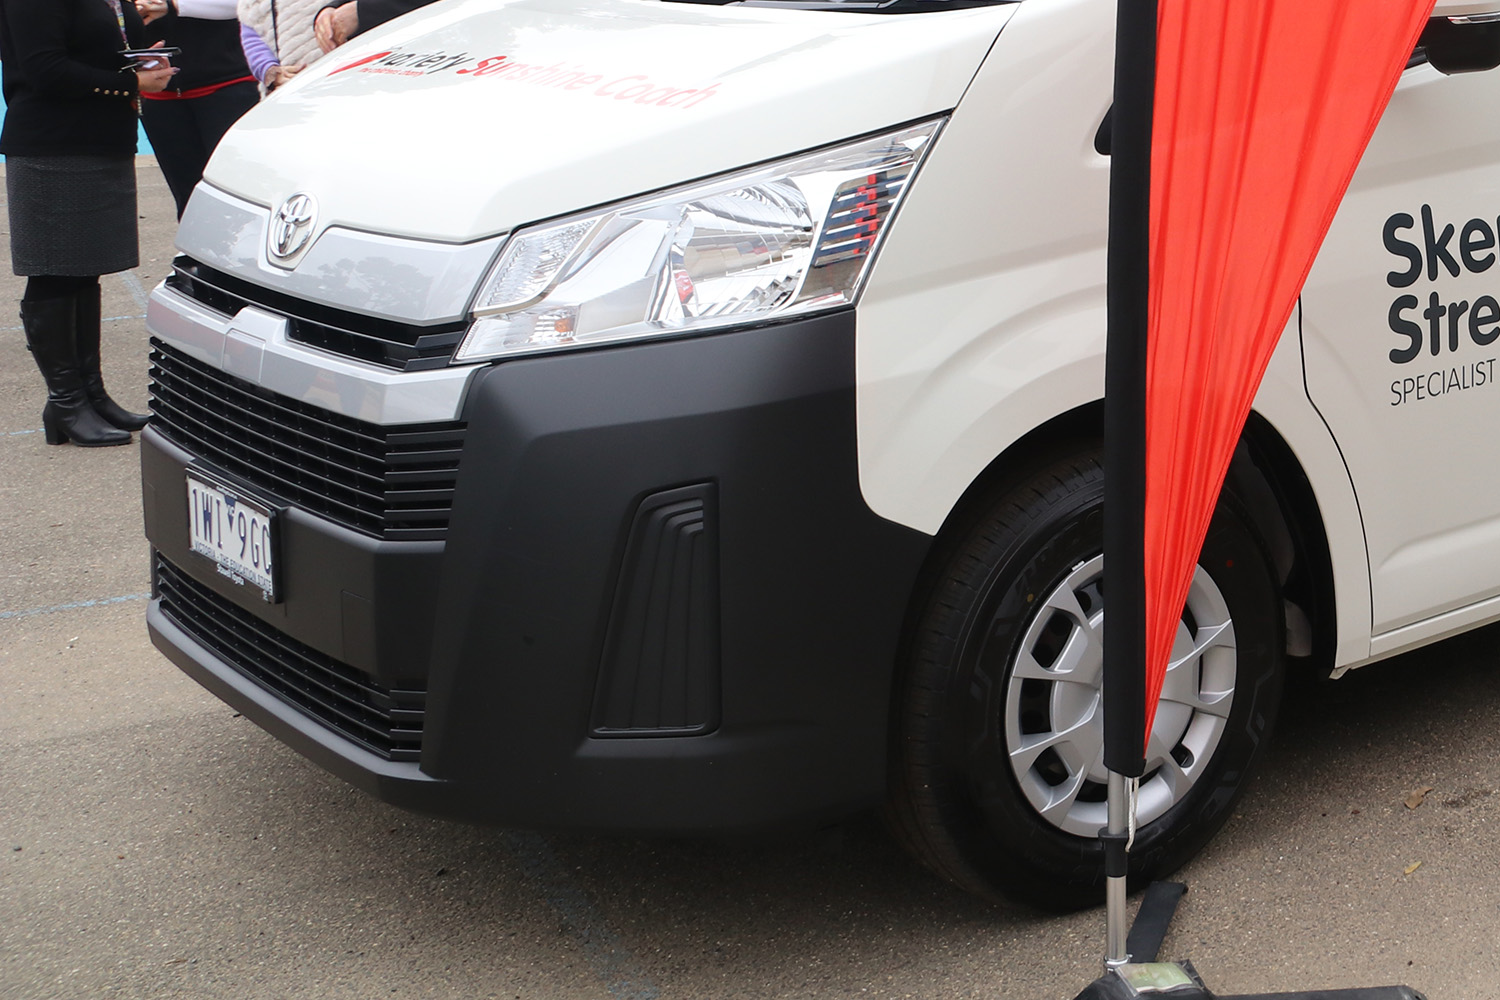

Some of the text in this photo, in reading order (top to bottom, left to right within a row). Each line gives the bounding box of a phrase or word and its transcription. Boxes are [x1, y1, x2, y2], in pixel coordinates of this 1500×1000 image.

[378, 50, 722, 109] variety Sunshine Coach
[1390, 358, 1497, 407] SPECIALIST
